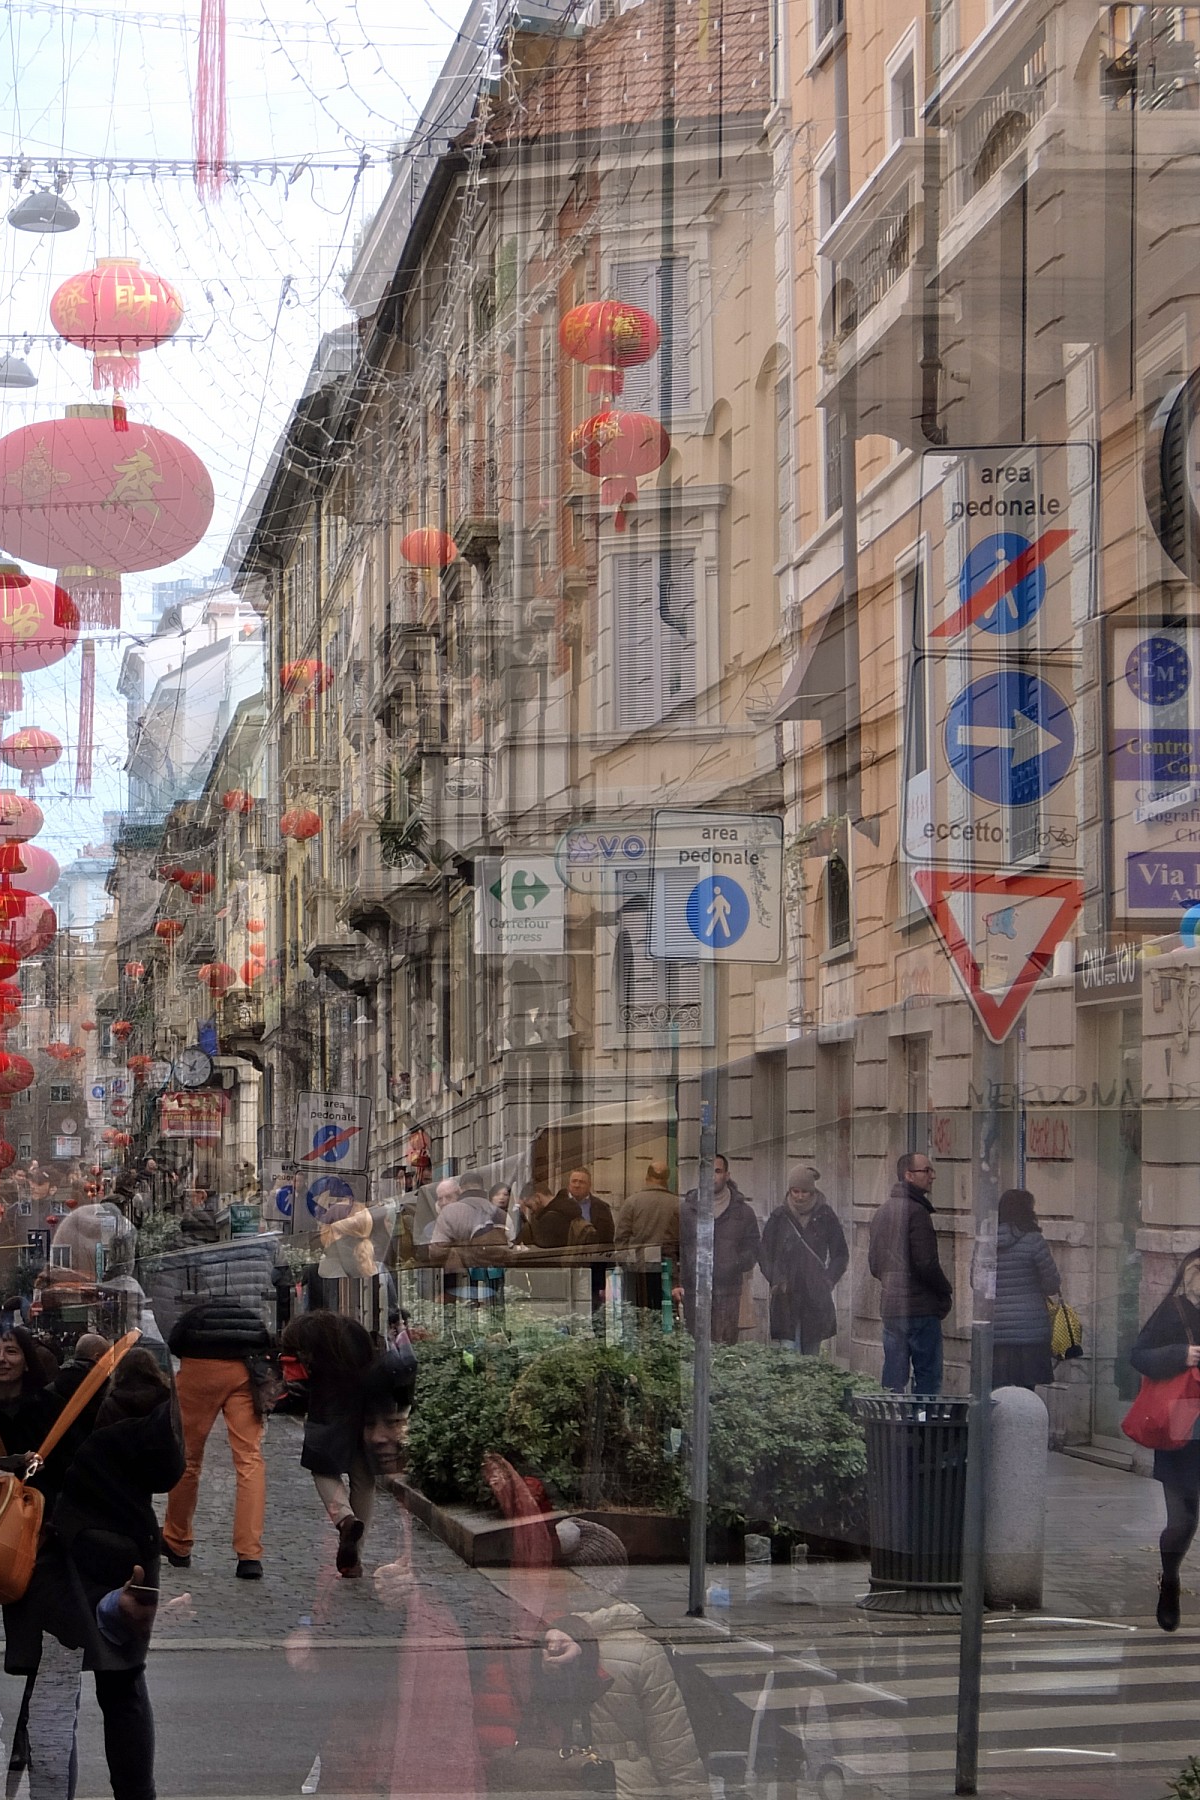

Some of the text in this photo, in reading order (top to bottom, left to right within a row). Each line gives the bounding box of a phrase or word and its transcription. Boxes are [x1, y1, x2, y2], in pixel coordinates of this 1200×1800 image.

[981, 465, 1031, 484] area
[951, 494, 1061, 518] pedonale
[1126, 737, 1194, 755] Centro
[1134, 788, 1188, 803] Centro
[702, 826, 738, 841] area
[922, 820, 1011, 844] eccetto:
[679, 848, 759, 866] pedonale
[566, 871, 638, 883] TUTTO
[1138, 863, 1186, 886] Via
[489, 917, 551, 929] Carrefour
[497, 933, 543, 944] express
[1114, 941, 1136, 984] YOU
[323, 1100, 345, 1109] area
[310, 1110, 357, 1121] pedonale
